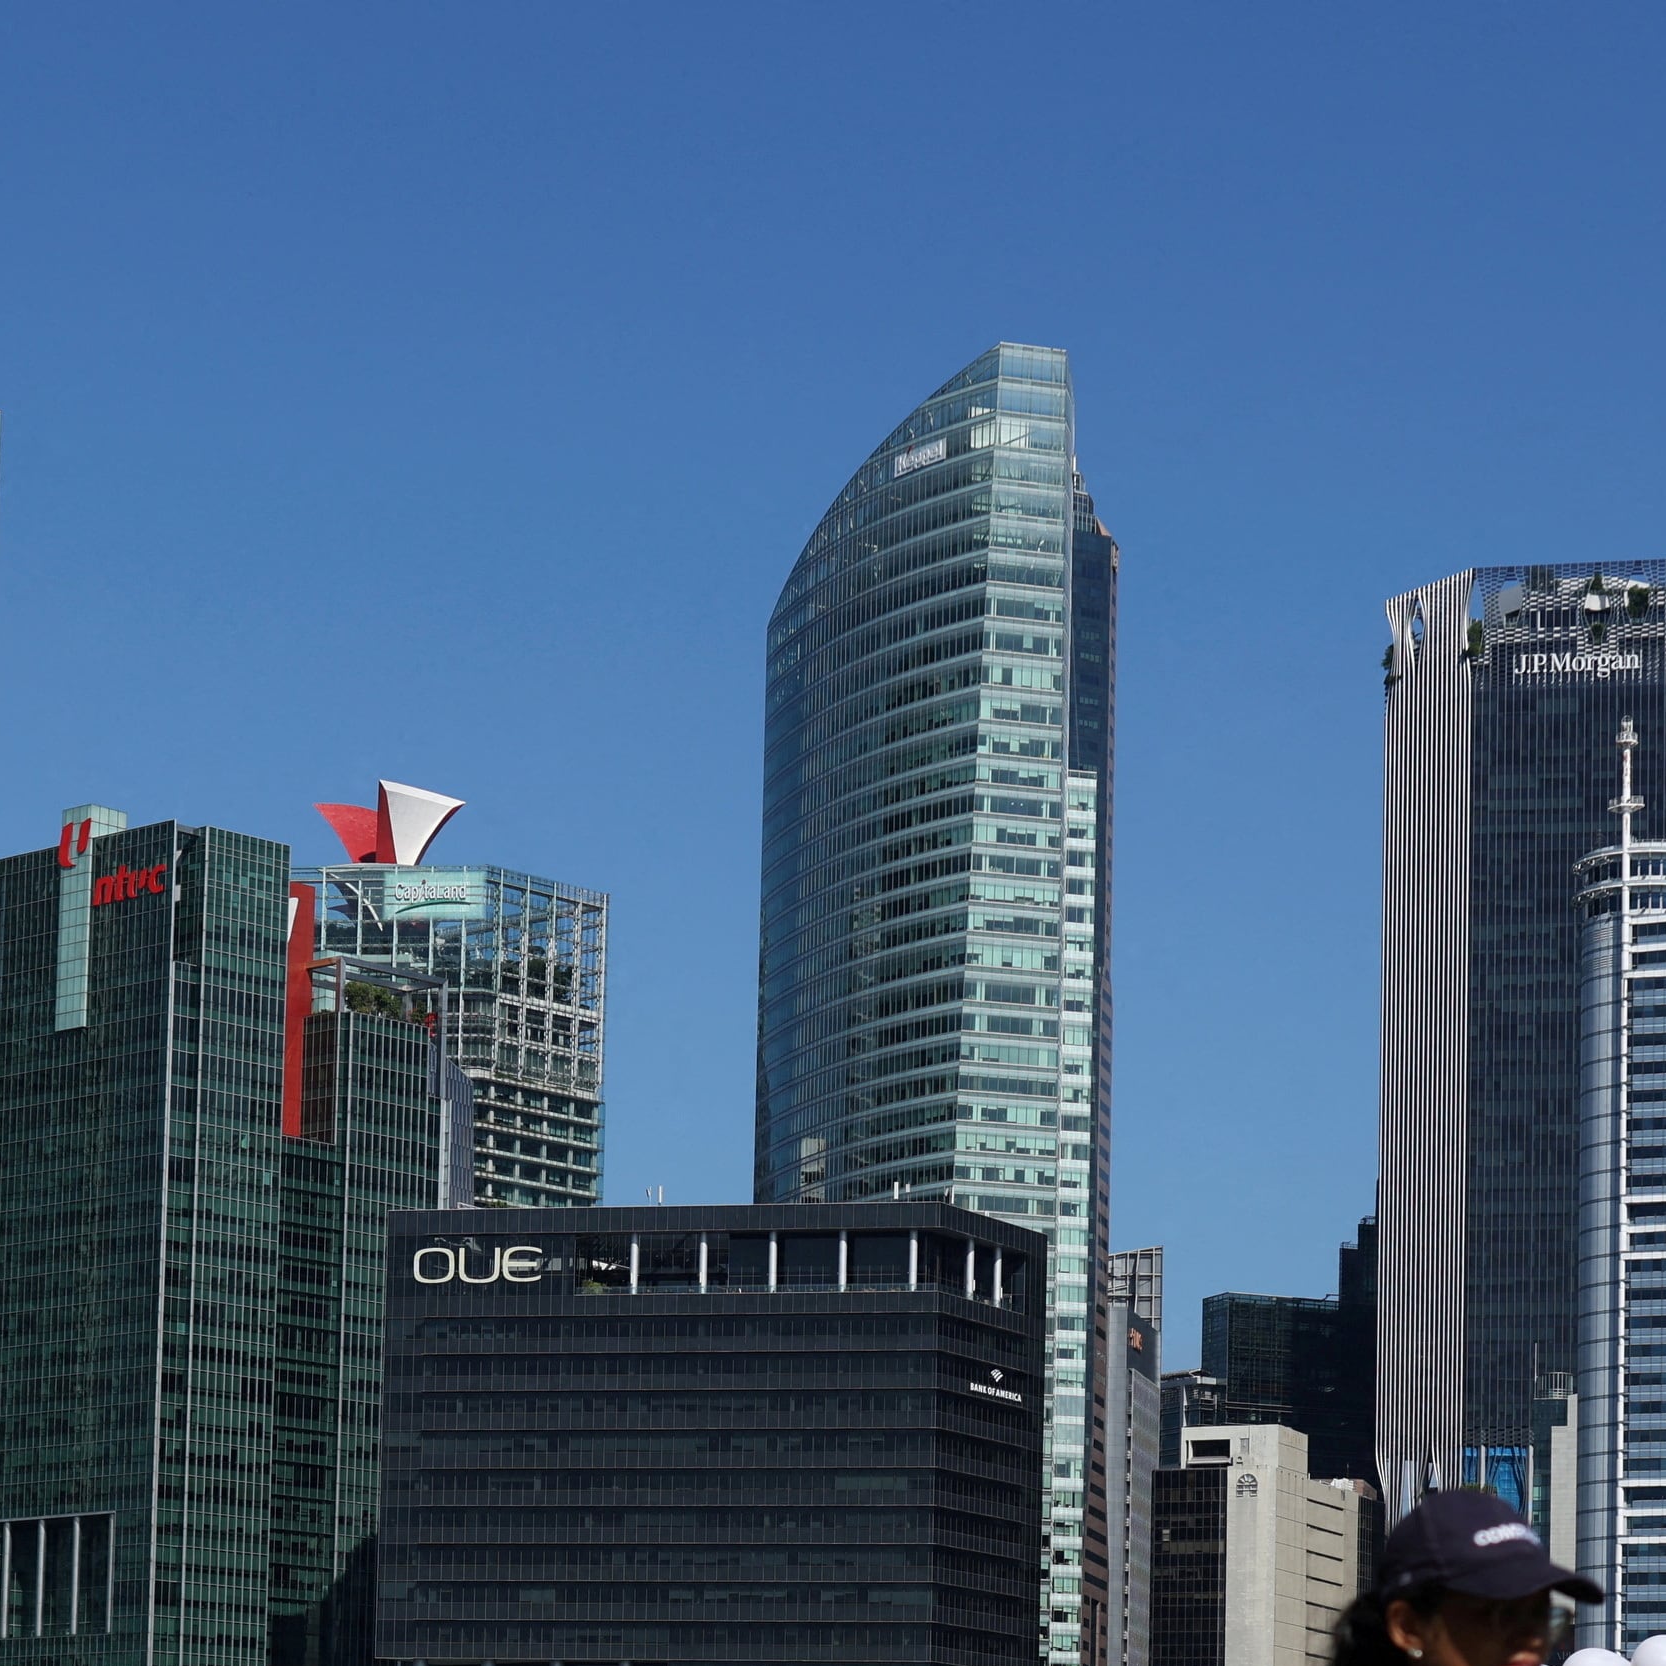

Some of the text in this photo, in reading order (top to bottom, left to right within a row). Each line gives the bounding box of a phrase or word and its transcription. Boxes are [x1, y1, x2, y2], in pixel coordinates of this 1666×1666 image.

[92, 863, 167, 906] ntuc
[395, 879, 469, 903] CapitaLand
[413, 1246, 543, 1284] OUE
[970, 1382, 1022, 1402] BANK OF AMERICA
